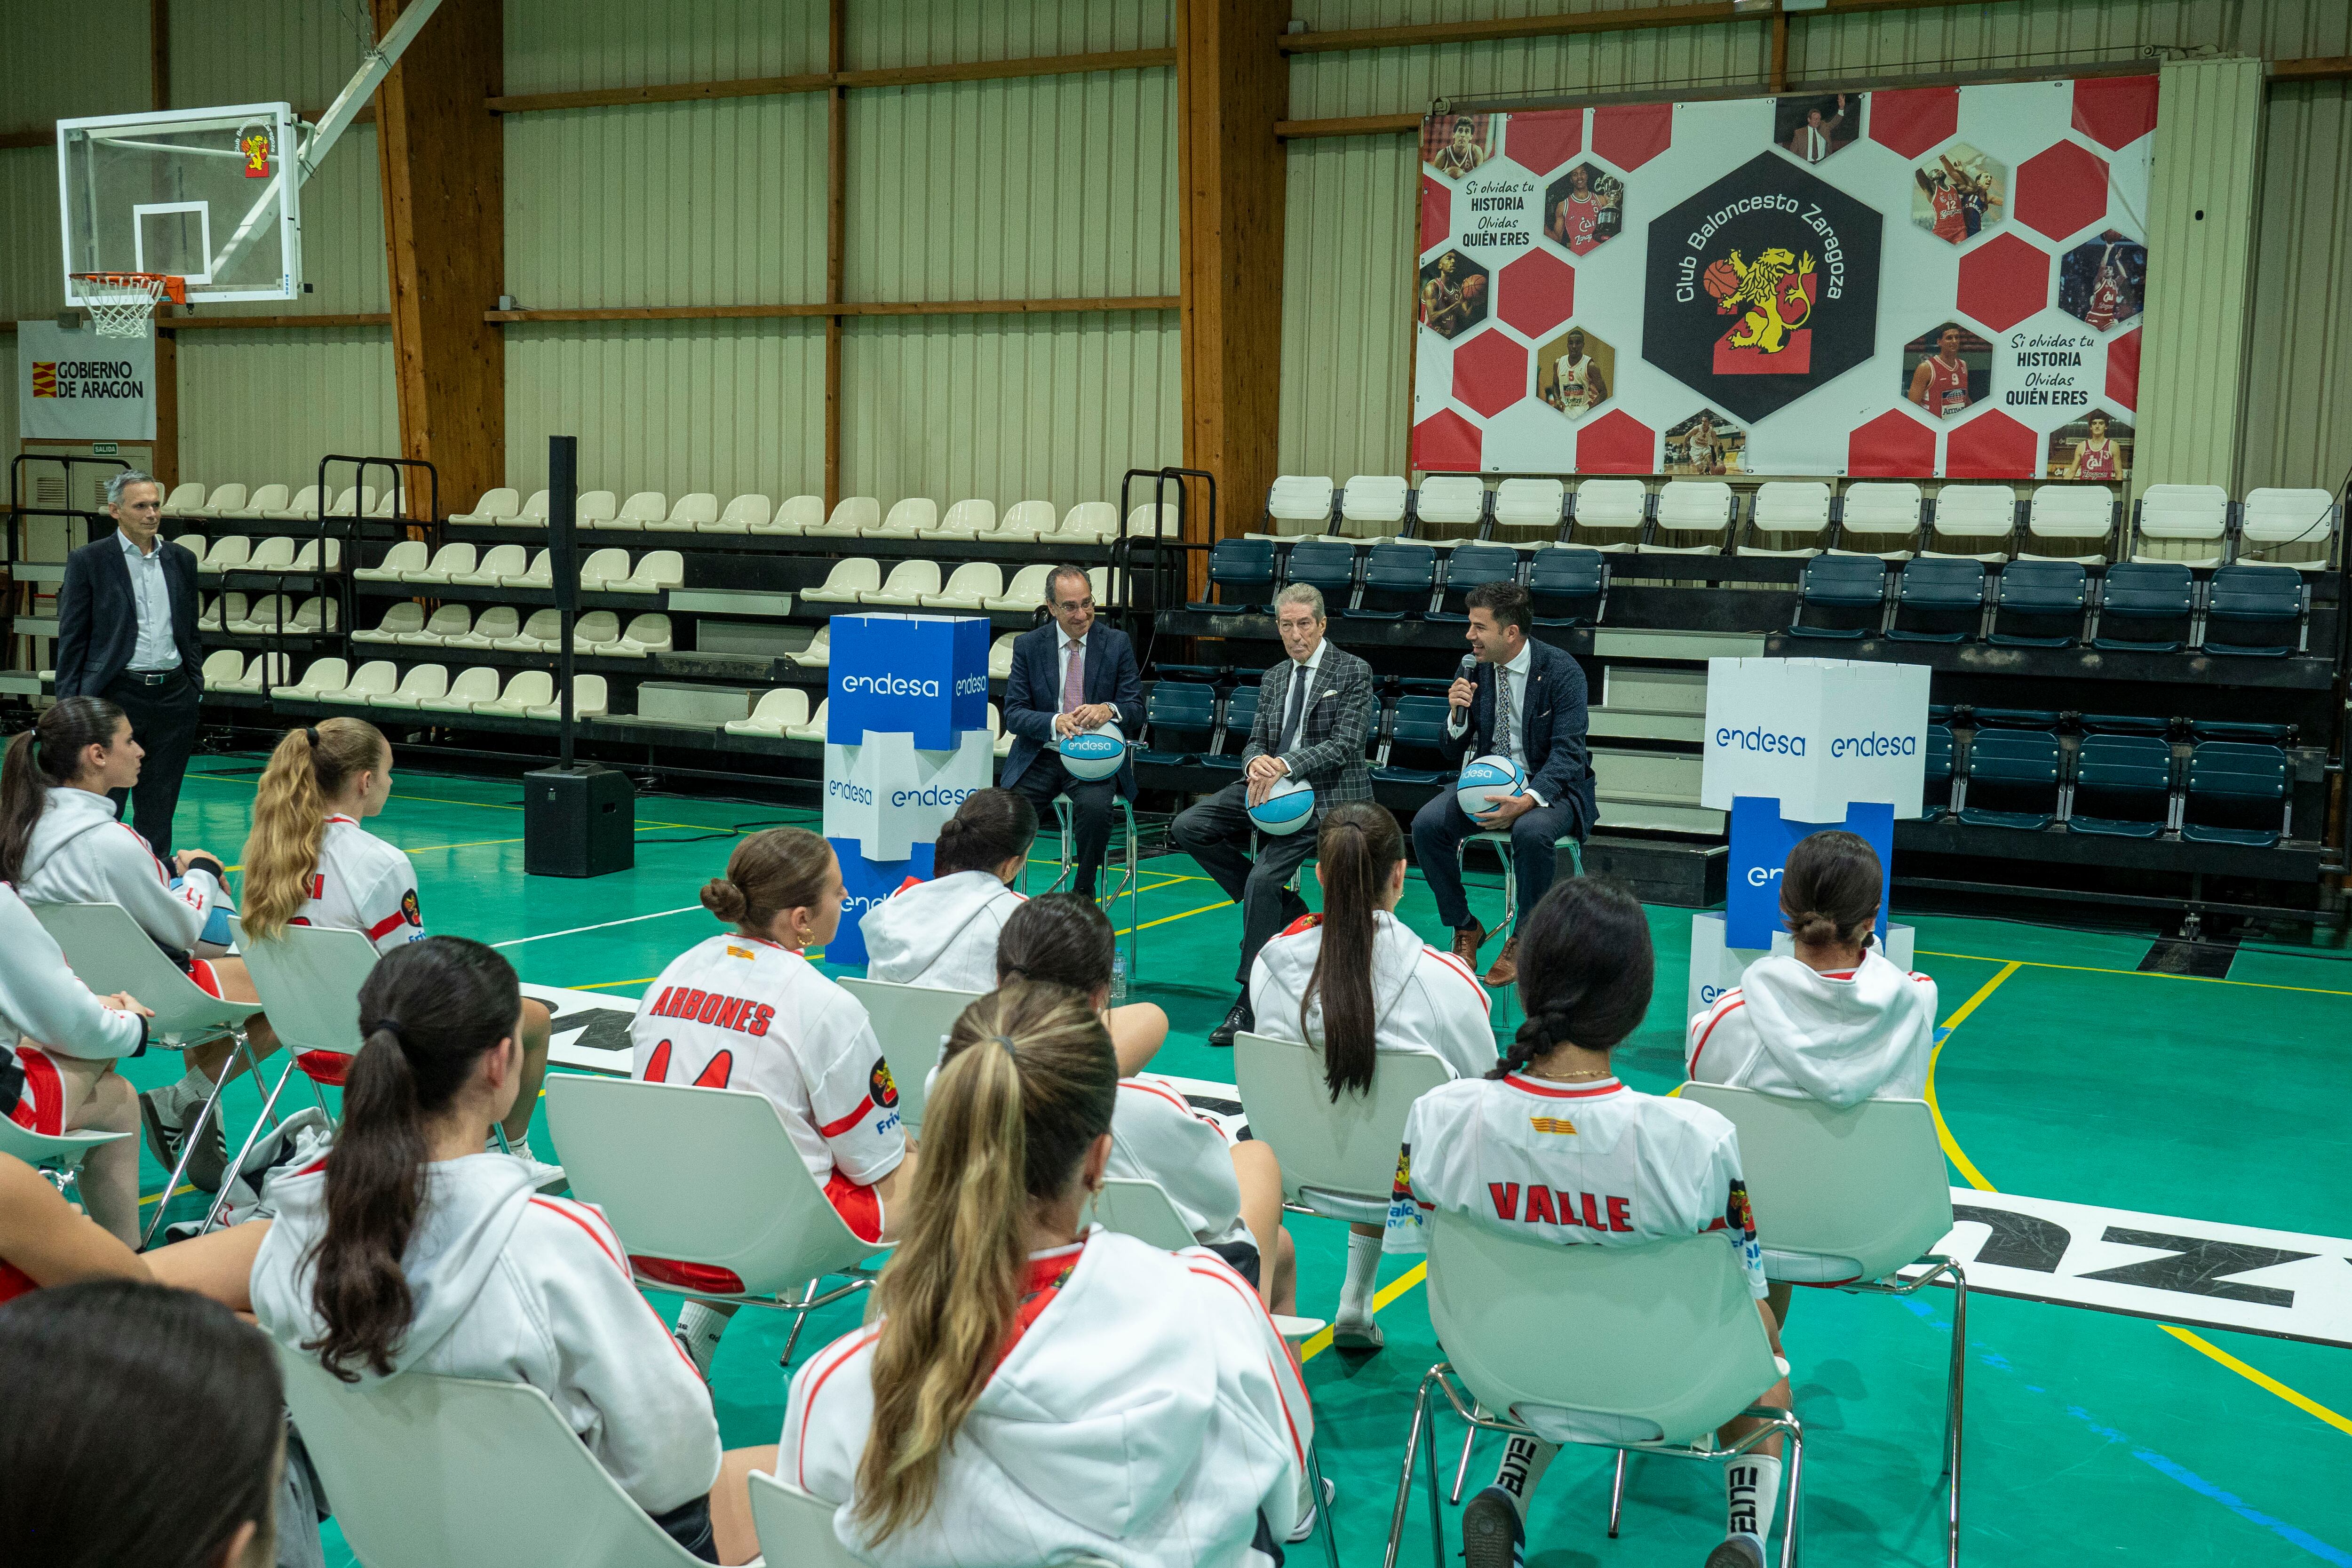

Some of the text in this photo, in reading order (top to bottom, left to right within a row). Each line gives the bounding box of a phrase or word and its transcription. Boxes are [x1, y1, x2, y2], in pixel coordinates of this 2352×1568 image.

[1466, 181, 1534, 195] Si olvidas tu
[1471, 197, 1524, 211] HISTORIA
[1946, 200, 1957, 210] 12
[1478, 216, 1518, 229] Olvidas
[1463, 230, 1529, 247] QUIÉN ERES
[1677, 194, 1844, 302] Club Baloncesto Zaragoza
[2011, 333, 2094, 349] Si olvidas tu
[2017, 352, 2081, 366] HISTORIA
[58, 361, 132, 379] GOBIERNO
[1952, 373, 1959, 385] 9
[2025, 373, 2074, 386] Olvidas
[58, 381, 143, 398] DE ARAGON
[2006, 388, 2088, 406] QUIÉN ERES
[2099, 450, 2110, 459] 13
[842, 673, 938, 697] endesa
[956, 673, 986, 696] endesa
[1069, 740, 1111, 750] endesa
[1716, 726, 1805, 756] endesa
[1831, 731, 1915, 757] endesa
[829, 780, 872, 806] endesa
[649, 986, 776, 1037] ARBONES
[1488, 1182, 1634, 1232] VALLE
